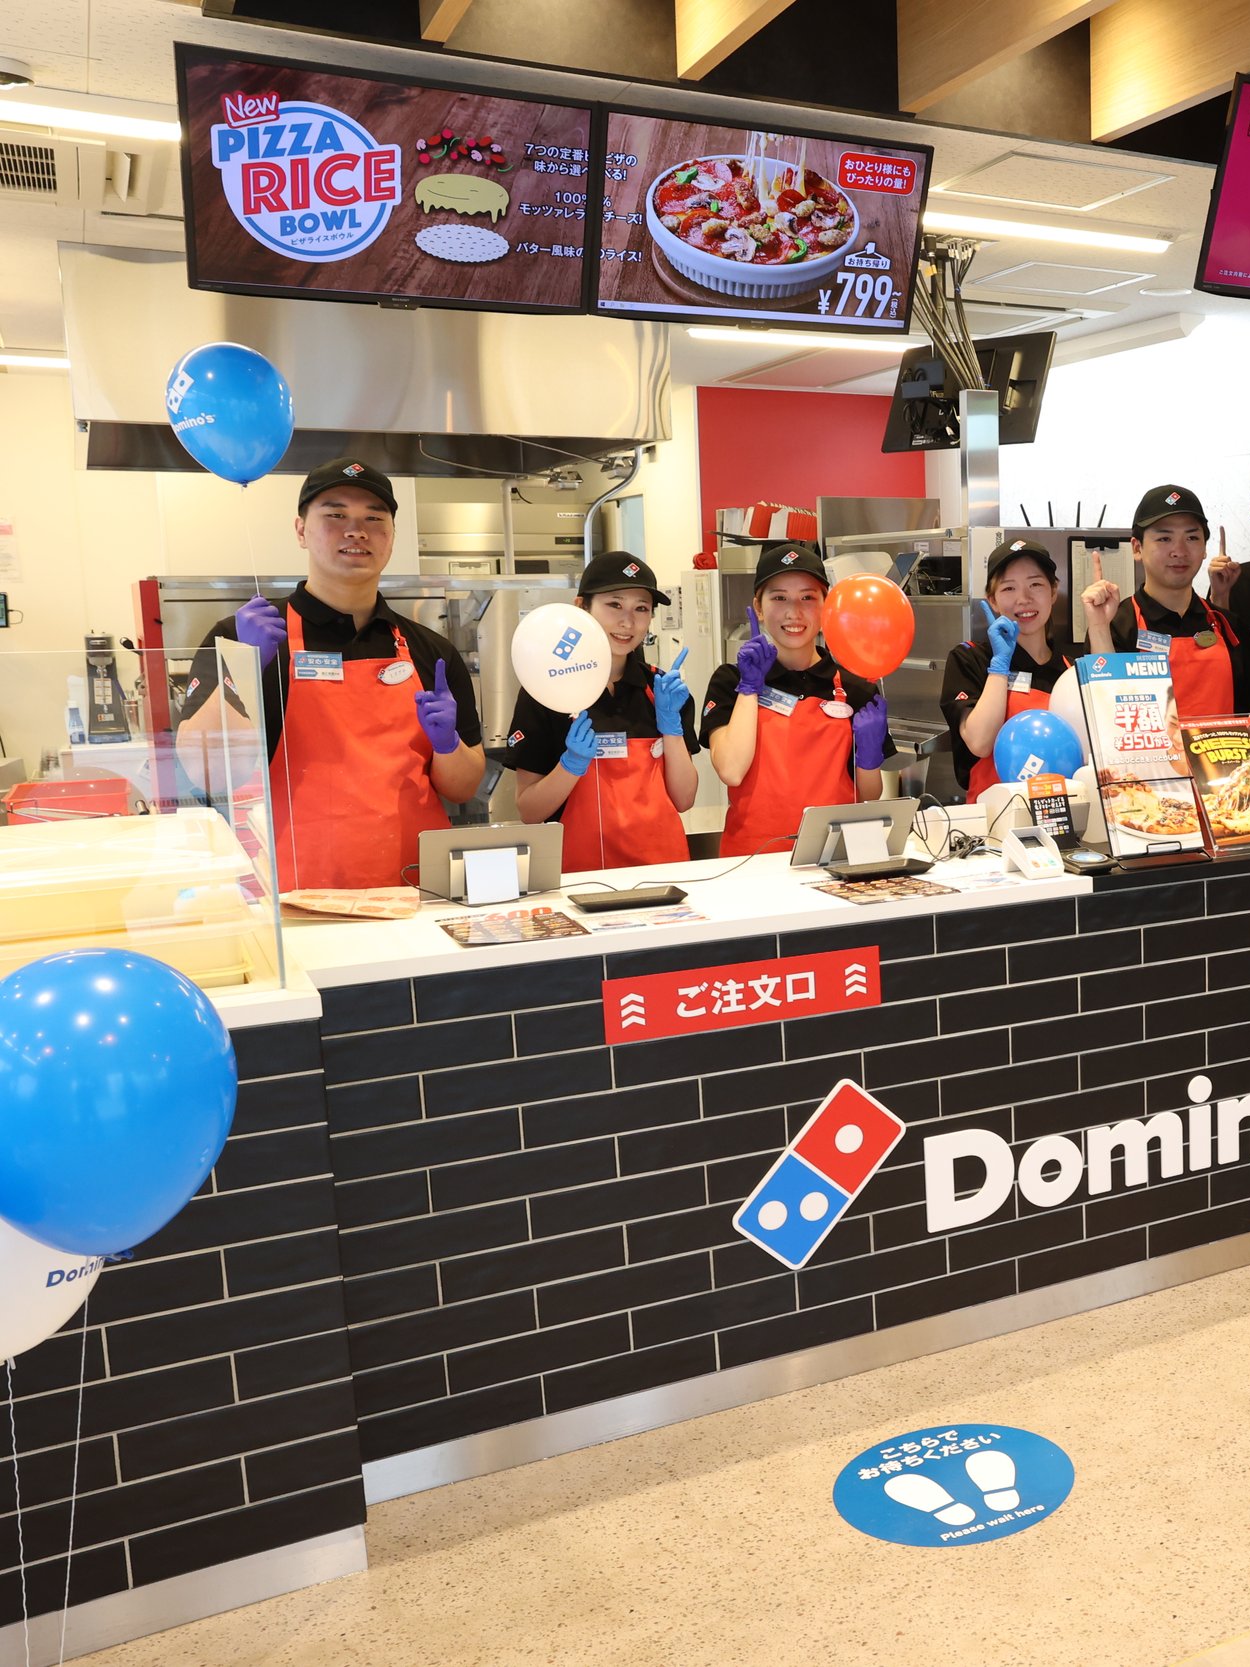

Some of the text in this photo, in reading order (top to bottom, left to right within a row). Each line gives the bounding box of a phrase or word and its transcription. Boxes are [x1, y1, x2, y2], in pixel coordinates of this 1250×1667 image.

[225, 94, 278, 119] New
[218, 121, 343, 162] PIZZA
[844, 159, 911, 177] おひとり様にも
[241, 150, 396, 216] RICE
[280, 208, 362, 237] BOWL
[291, 232, 354, 245] ピザライスボウル
[848, 257, 888, 268] お持ち帰り
[174, 412, 216, 432] mino's
[548, 660, 598, 677] Domino's
[1126, 662, 1168, 676] MENU
[1115, 703, 1165, 733] 半額
[1206, 749, 1247, 764] BURST
[675, 969, 817, 1021] ご注文口
[857, 1432, 1001, 1480] お待ちください
[880, 1430, 959, 1459] こちらで
[940, 1504, 1045, 1542] Please wait here
